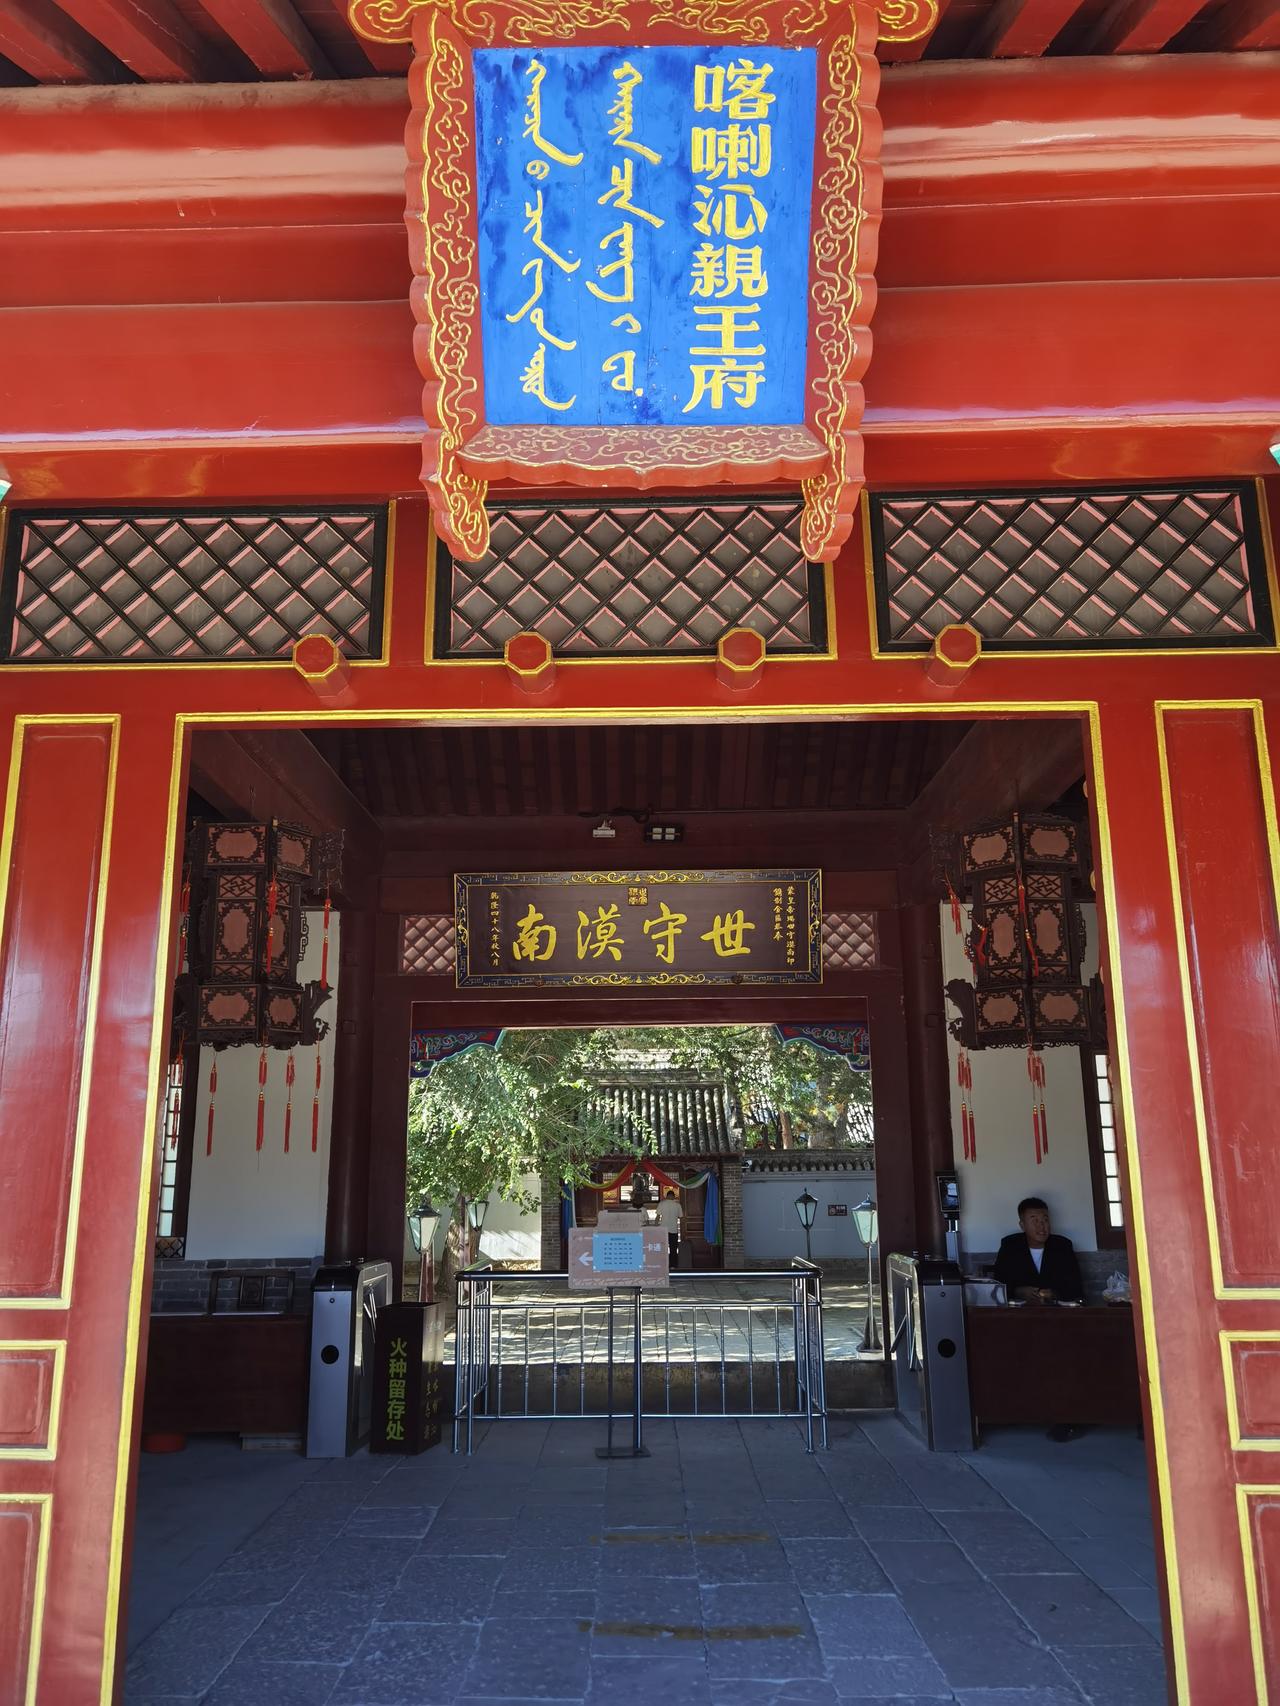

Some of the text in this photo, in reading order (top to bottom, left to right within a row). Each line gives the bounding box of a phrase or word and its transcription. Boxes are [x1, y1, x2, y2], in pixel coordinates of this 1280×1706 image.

[682, 58, 776, 413] 喀喇沁親王府
[386, 1337, 407, 1441] 火种留存处
